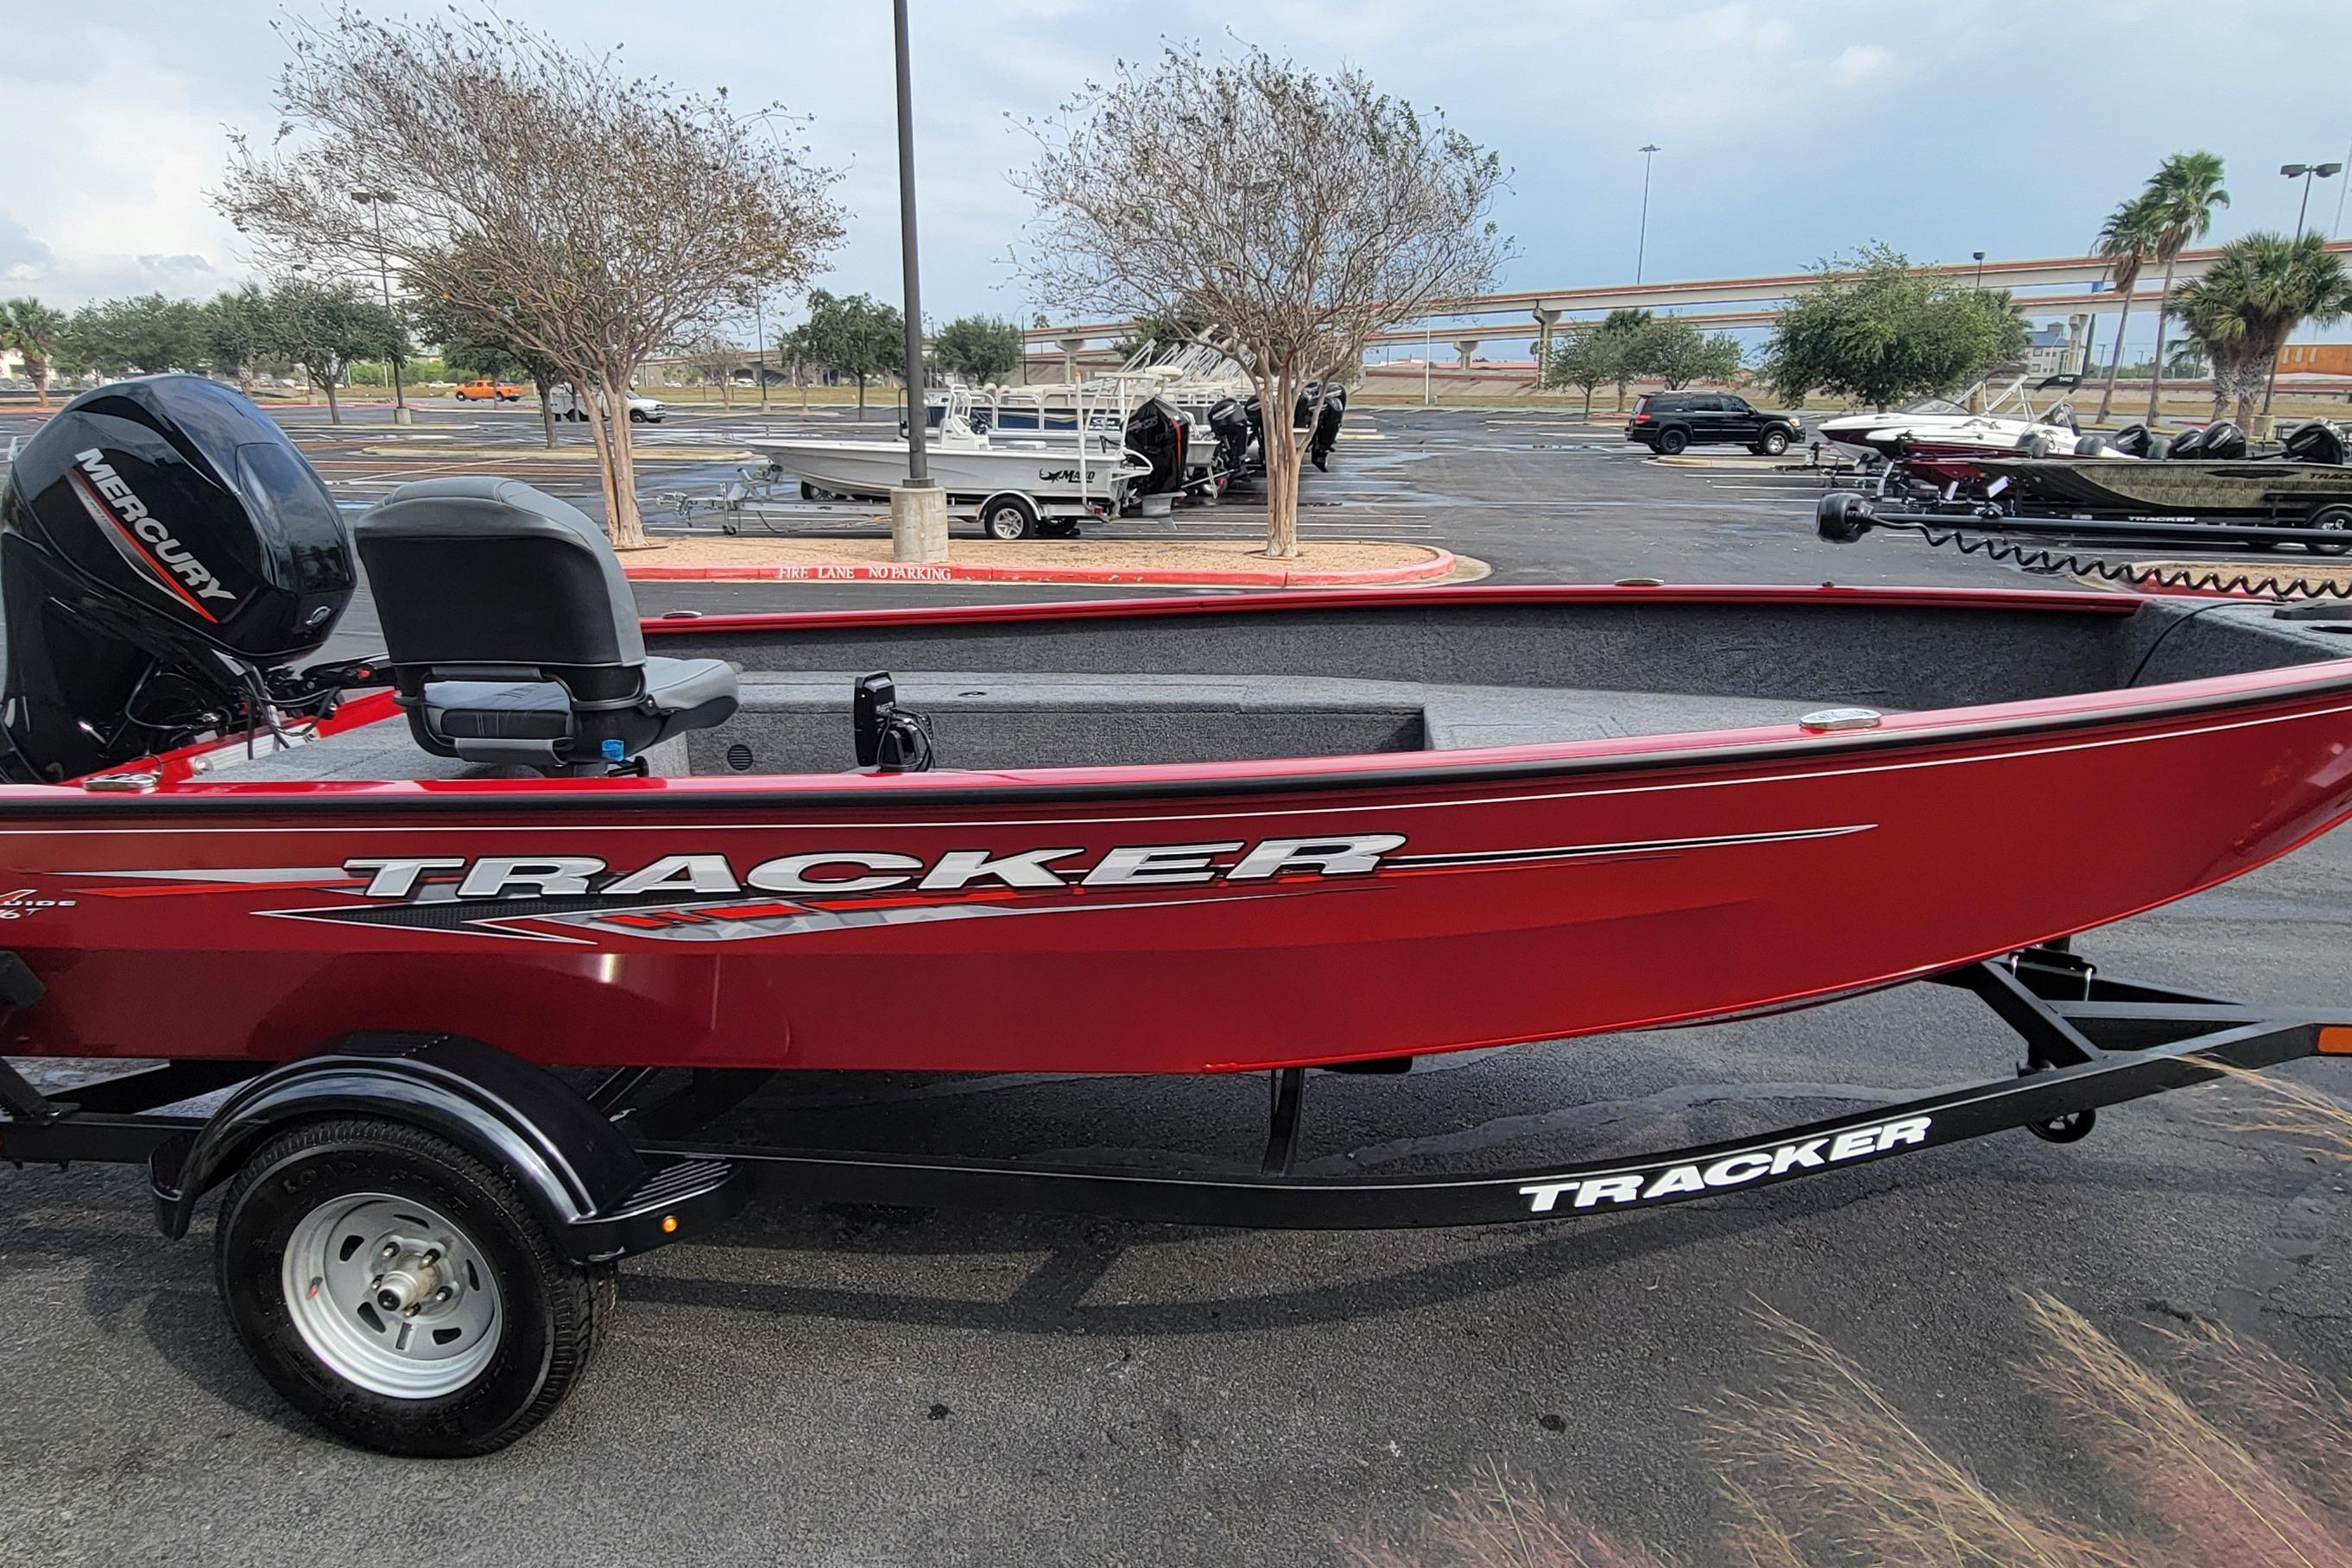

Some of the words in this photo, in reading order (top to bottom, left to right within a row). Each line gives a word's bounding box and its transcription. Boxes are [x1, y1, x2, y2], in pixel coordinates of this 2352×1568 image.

[75, 447, 237, 599] MERCURY
[780, 566, 808, 579] FIRE
[818, 566, 855, 579] LANE
[869, 566, 888, 579] NO
[891, 566, 952, 580] PARKING
[345, 833, 1408, 896] TRACKER
[1519, 1116, 1932, 1212] TRACKER
